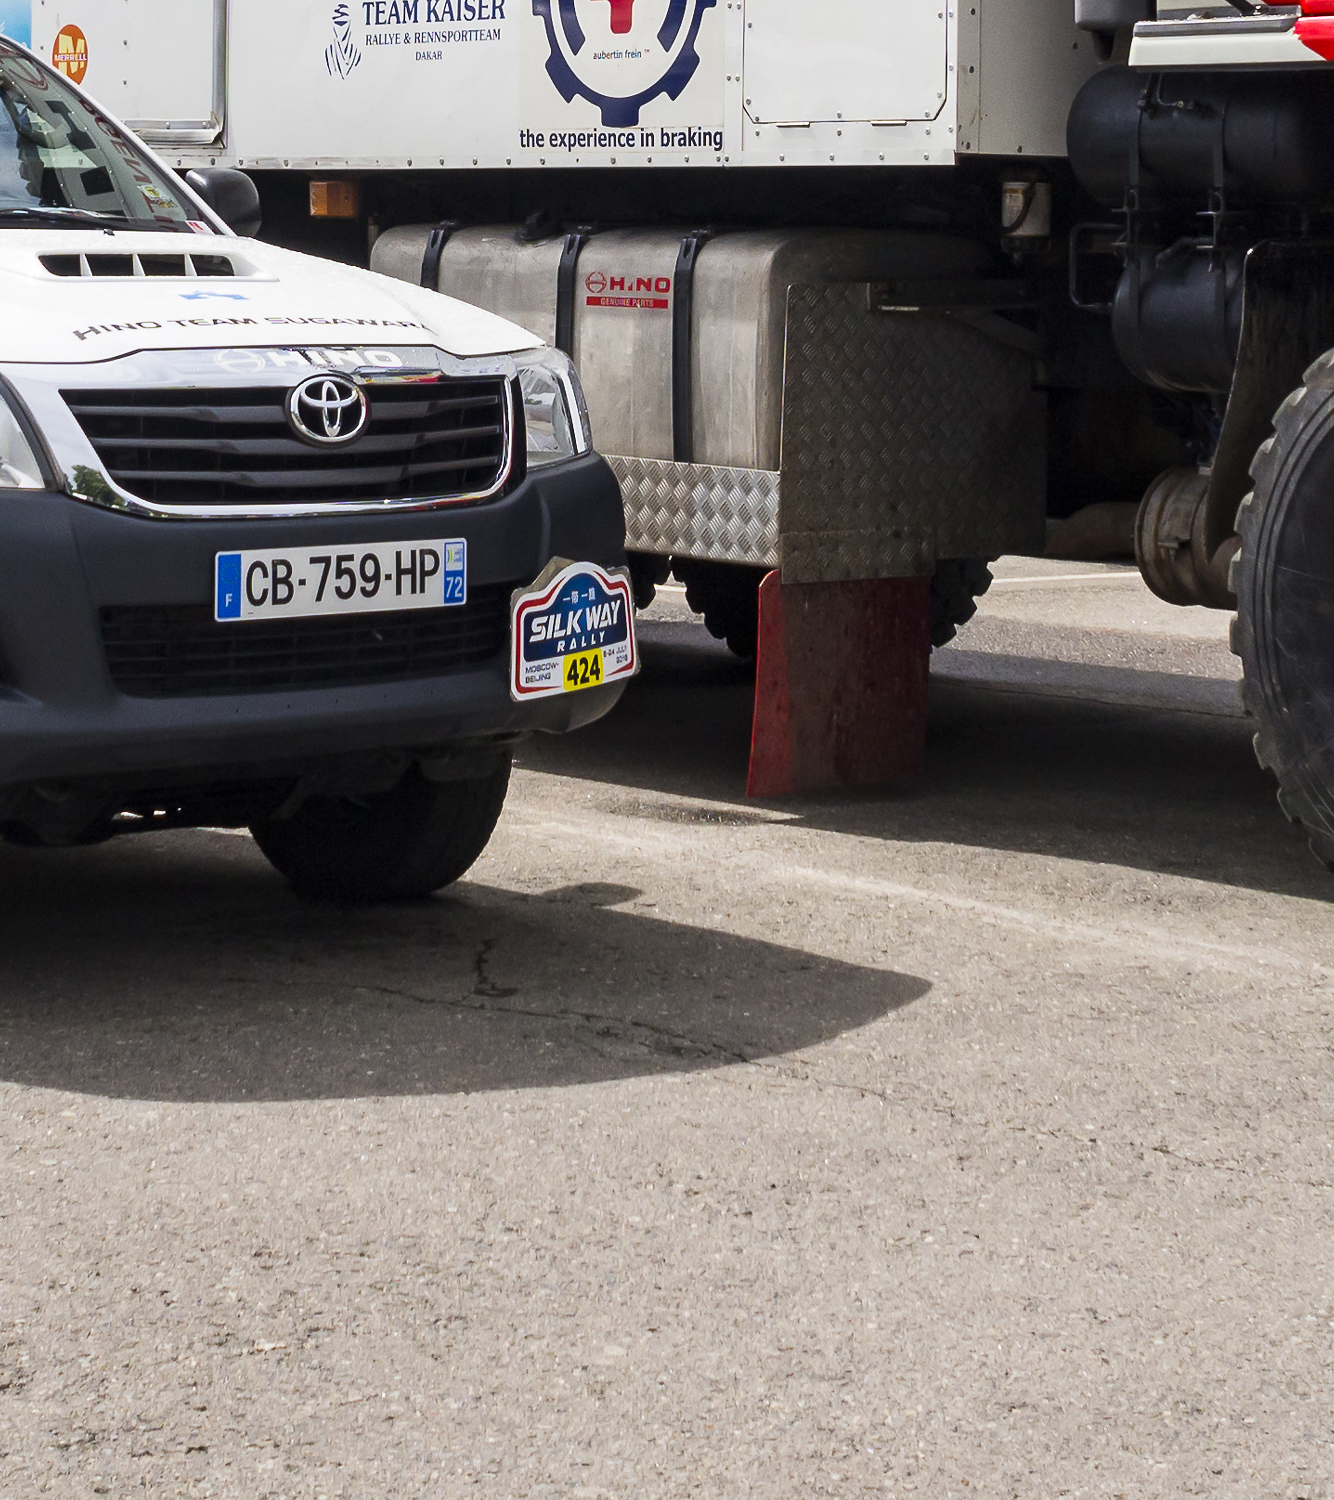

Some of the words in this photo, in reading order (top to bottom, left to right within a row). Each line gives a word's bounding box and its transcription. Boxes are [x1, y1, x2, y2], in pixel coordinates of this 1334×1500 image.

[362, 0, 419, 26] TEAM
[365, 32, 401, 46] RALLYE
[403, 32, 411, 45] &
[414, 29, 501, 45] RENNSPORTTEAM
[54, 53, 88, 62] MERRELL
[415, 51, 443, 61] DAKAR
[593, 49, 623, 61] aubertin
[624, 48, 643, 60] frein
[519, 128, 546, 148] the
[548, 129, 636, 153] experience
[640, 127, 656, 148] in
[660, 127, 723, 152] braking
[601, 297, 630, 306] GENUINE
[72, 321, 162, 341] HINO
[167, 317, 258, 328] TEAM
[264, 316, 439, 337] SUGAWARA
[266, 346, 405, 370] HINO
[246, 548, 441, 607] CB-759-HP
[445, 576, 464, 598] 72
[225, 593, 233, 607] F
[530, 608, 584, 642] SILK
[585, 599, 622, 631] WAY
[557, 630, 606, 653] RALLY
[525, 672, 552, 684] BEIJING
[567, 654, 601, 686] 424
